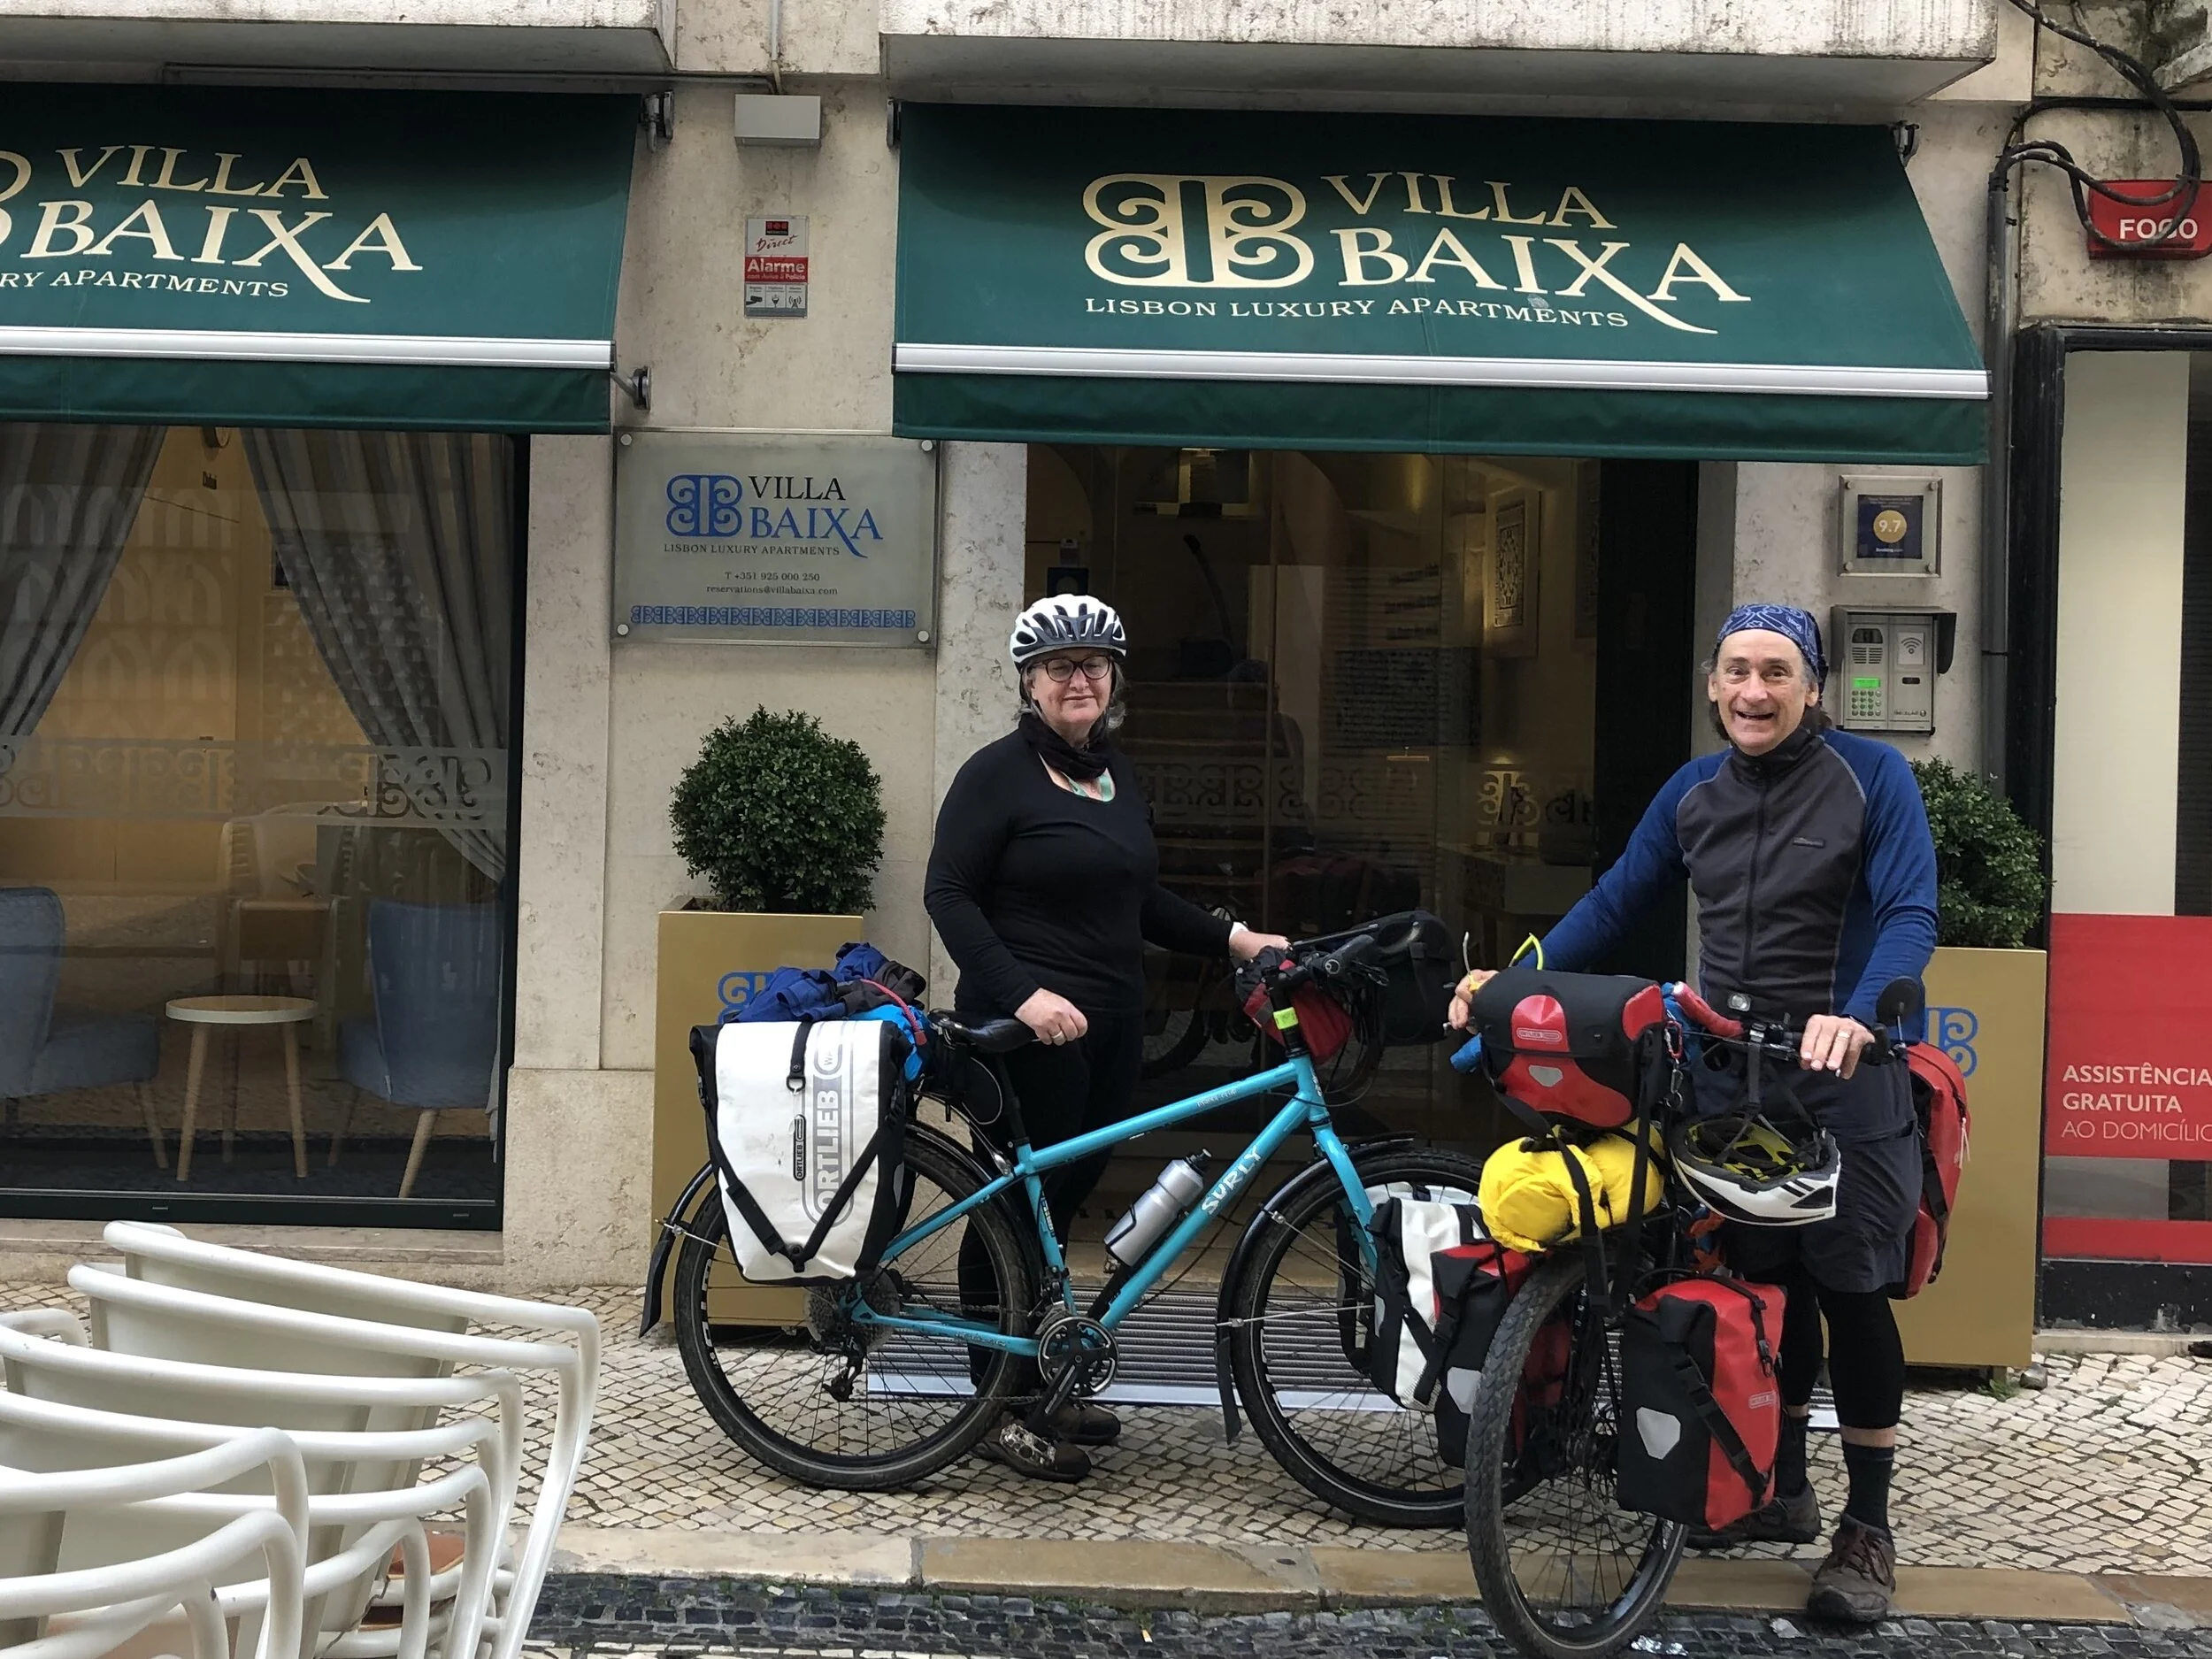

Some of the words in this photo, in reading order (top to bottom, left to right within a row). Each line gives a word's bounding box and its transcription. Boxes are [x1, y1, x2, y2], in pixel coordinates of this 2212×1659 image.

[55, 144, 330, 199] VILLA
[1321, 172, 1617, 229] VILLA
[19, 199, 424, 303] BAIXA
[747, 258, 805, 273] Alarme
[50, 270, 289, 298] APARTMENTS
[1329, 227, 1752, 334] BAIXA
[1085, 297, 1217, 318] LISBON
[1230, 298, 1373, 318] LUXURY
[1386, 297, 1630, 328] APARTMENTS
[749, 476, 847, 501] VILLA
[750, 507, 884, 558] BAIXA
[1879, 519, 1901, 533] 9.7
[664, 544, 708, 553] LISBON
[710, 545, 758, 554] LUXURY
[762, 546, 841, 556] APARTMENTS
[725, 572, 733, 580] T
[781, 572, 800, 581] 000
[2062, 1062, 2212, 1087] ASSISTÊNCIA
[2062, 1093, 2182, 1113] GRATUITA
[2062, 1120, 2095, 1139] AO
[816, 1089, 840, 1213] ORTLIEB
[1202, 1145, 1262, 1215] SURLY
